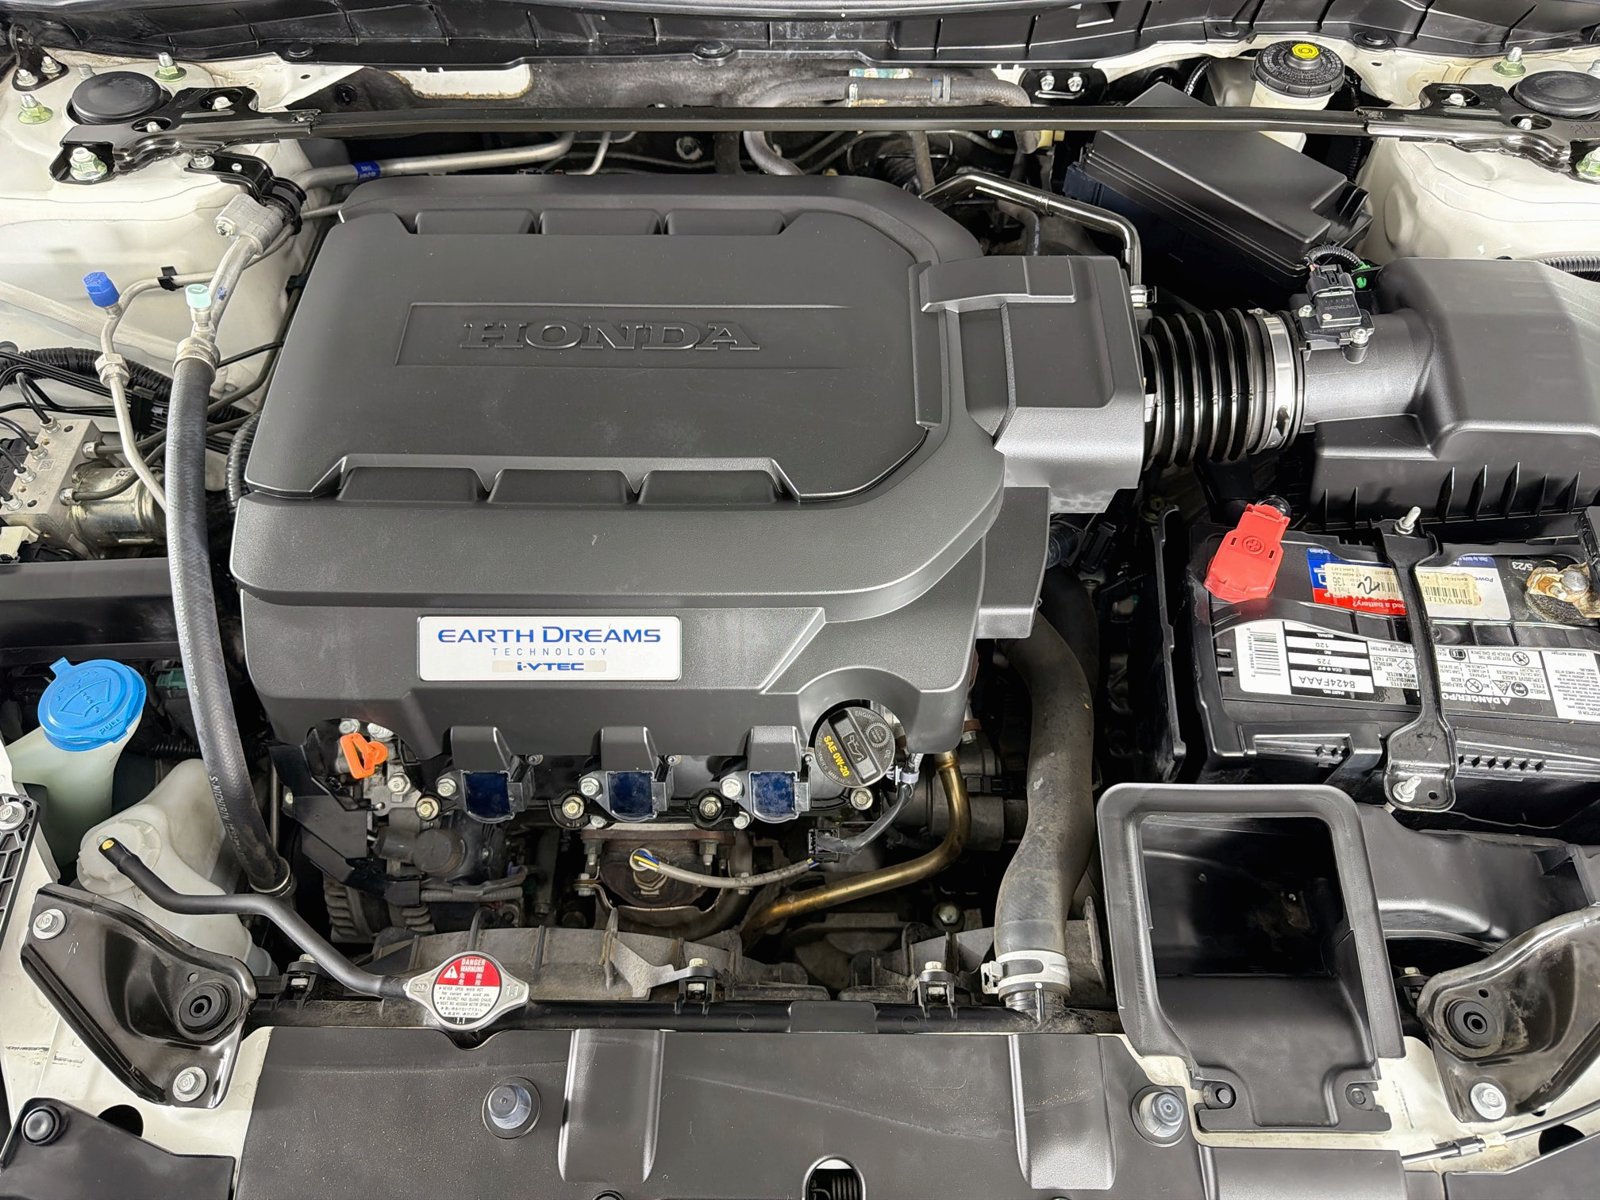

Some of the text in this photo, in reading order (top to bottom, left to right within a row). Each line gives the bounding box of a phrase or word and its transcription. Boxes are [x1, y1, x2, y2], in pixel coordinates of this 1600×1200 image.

[461, 321, 760, 350] HONDA
[1511, 561, 1533, 571] 5/23
[1352, 600, 1383, 608] battery?
[438, 629, 534, 643] EARTH
[492, 647, 607, 656] TECHNOLOGY
[1298, 675, 1355, 688] 8424FAAA
[1442, 693, 1501, 704] DANGER/PO
[98, 718, 123, 735] PULL
[824, 736, 838, 753] SAE
[833, 752, 850, 777] 0W-20
[462, 958, 486, 966] DANGER
